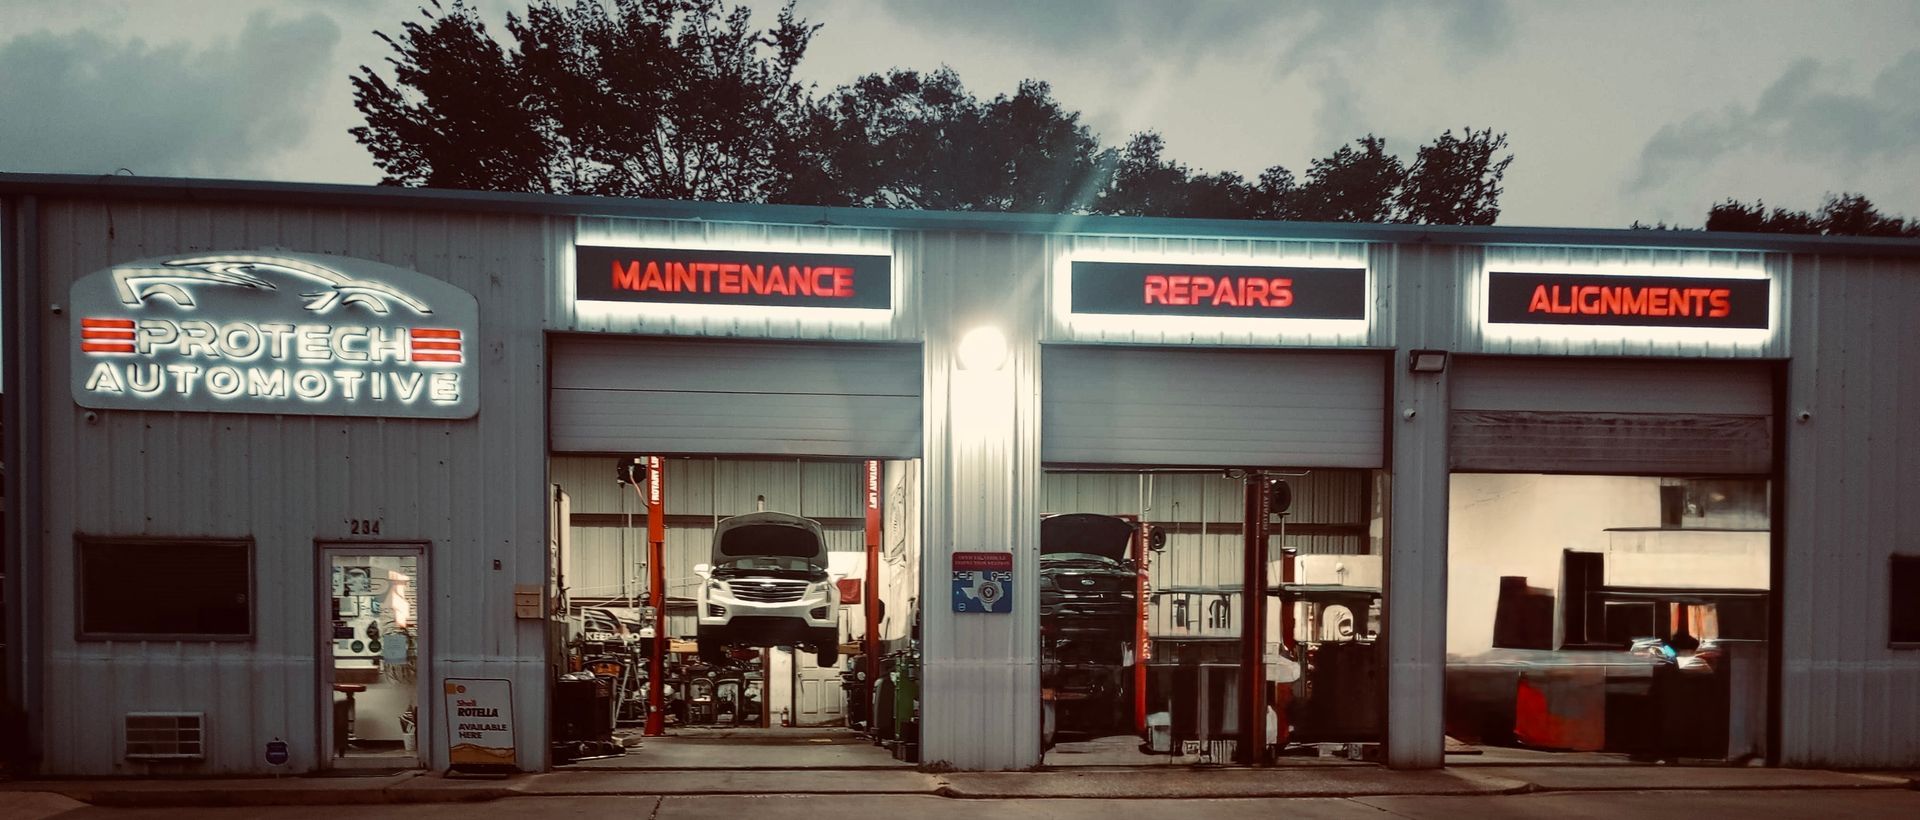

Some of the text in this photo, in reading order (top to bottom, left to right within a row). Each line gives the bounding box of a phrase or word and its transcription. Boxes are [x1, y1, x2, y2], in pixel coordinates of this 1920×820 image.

[611, 259, 855, 298] MAINTENANCE
[1144, 274, 1294, 308] REPAIRS
[1528, 284, 1731, 318] ALIGNMENTS
[137, 318, 409, 362] PROTECH
[85, 362, 460, 402] AUTOMOTIVE
[869, 492, 878, 509] LIFT
[457, 707, 499, 718] ROTELLA
[458, 723, 508, 732] AVAILABLE
[458, 731, 483, 739] HERE
